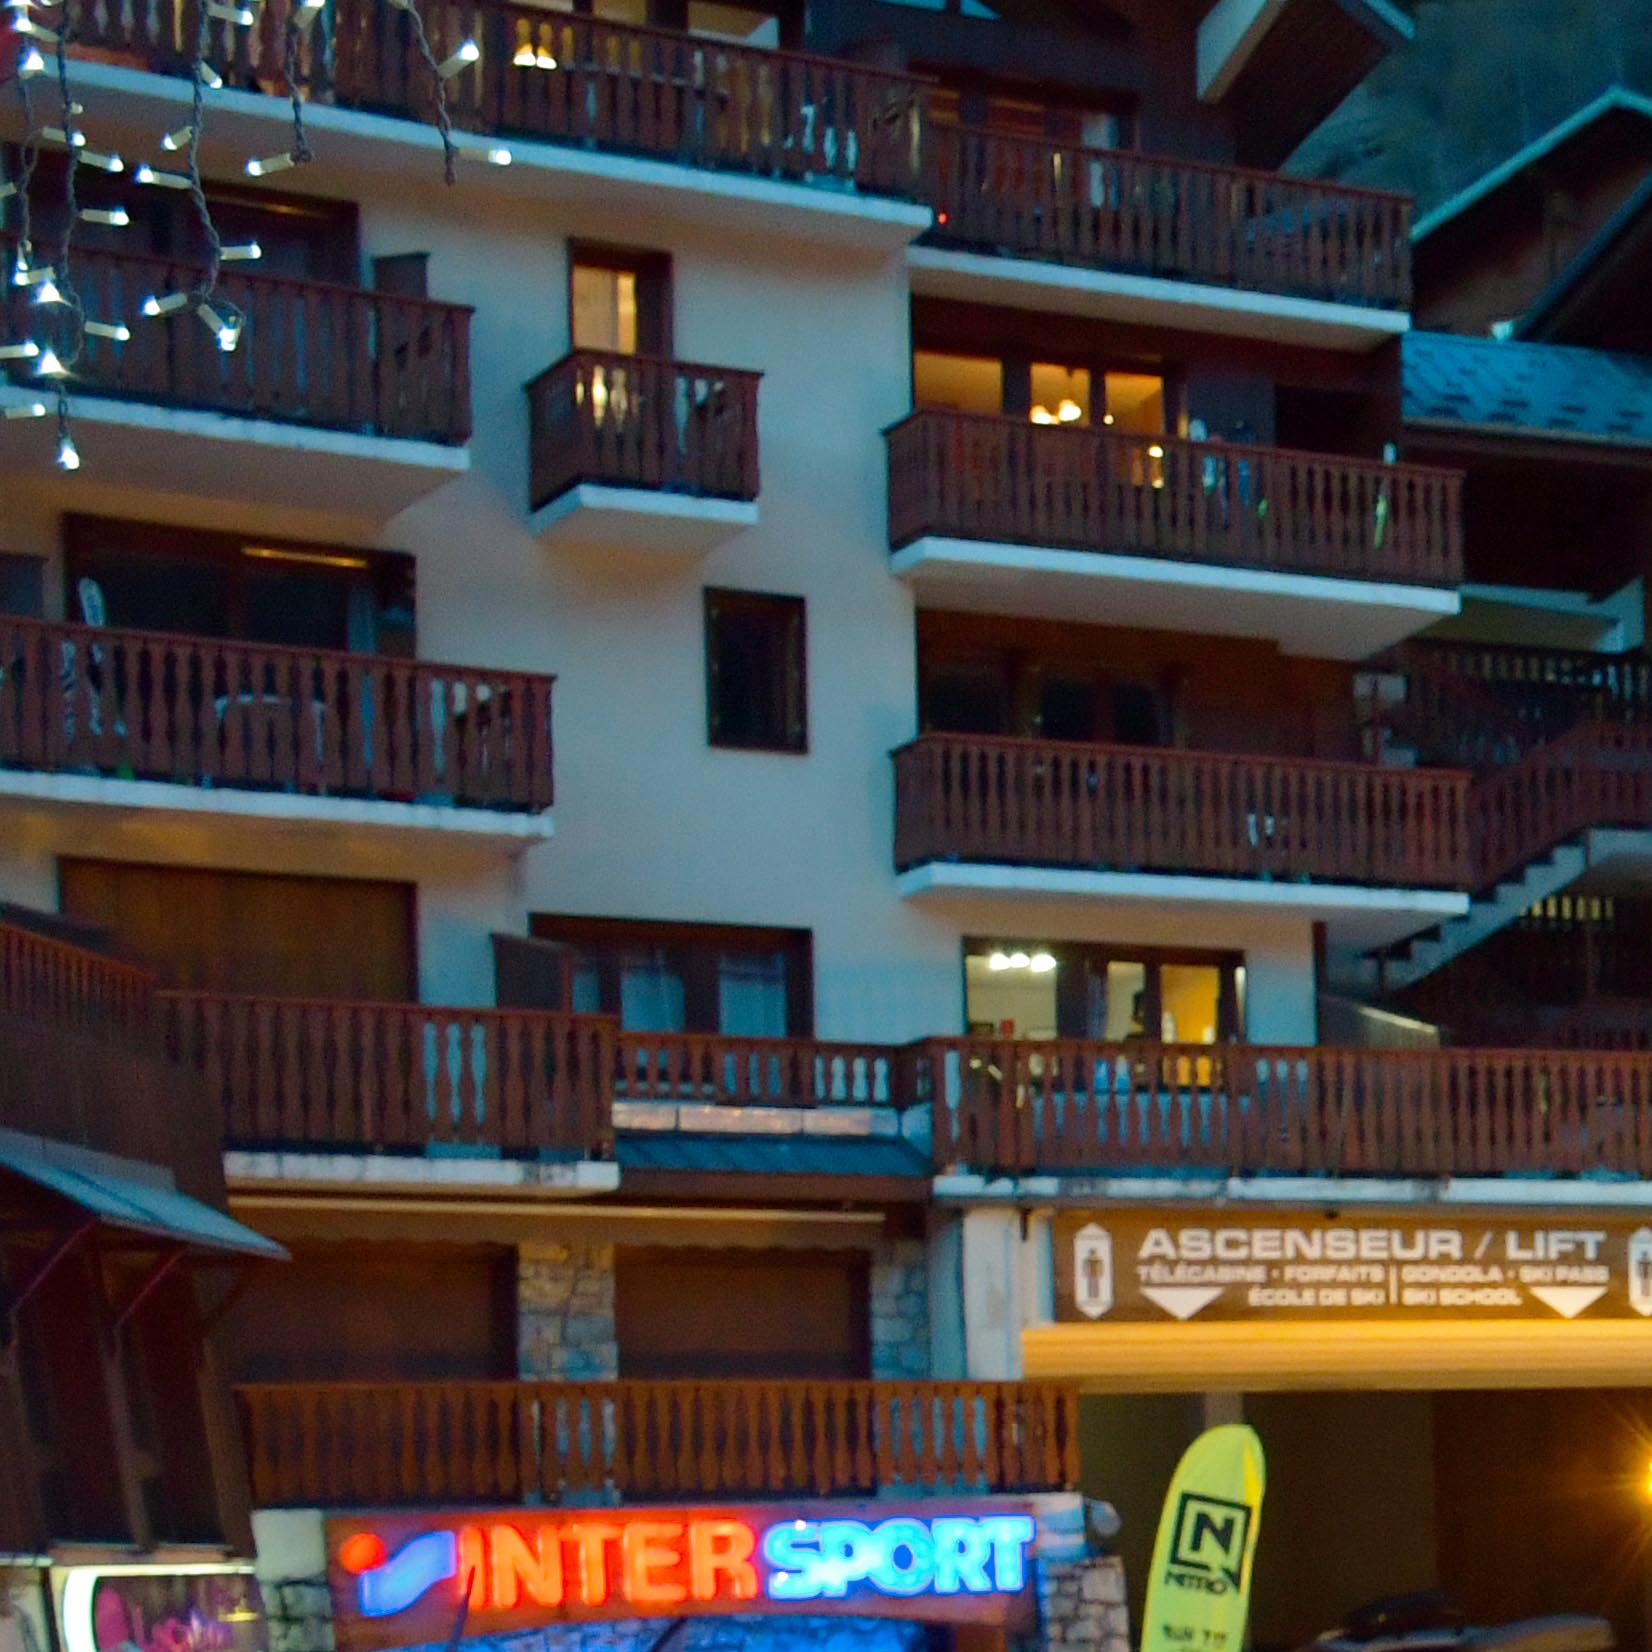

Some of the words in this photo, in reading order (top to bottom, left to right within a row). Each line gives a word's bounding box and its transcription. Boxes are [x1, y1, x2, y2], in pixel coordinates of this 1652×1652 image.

[1137, 1228, 1463, 1260] ASCENSEUR
[1505, 1229, 1607, 1260] LIFT
[1137, 1260, 1267, 1284] TÉLÉCABINE
[1283, 1264, 1386, 1284] FORFAITS
[1401, 1264, 1504, 1284] GONDOLA
[1318, 1287, 1348, 1307] DE
[1350, 1287, 1386, 1307] SKI
[1439, 1286, 1524, 1307] SCHOOL
[458, 1514, 1036, 1612] INTERSPORT
